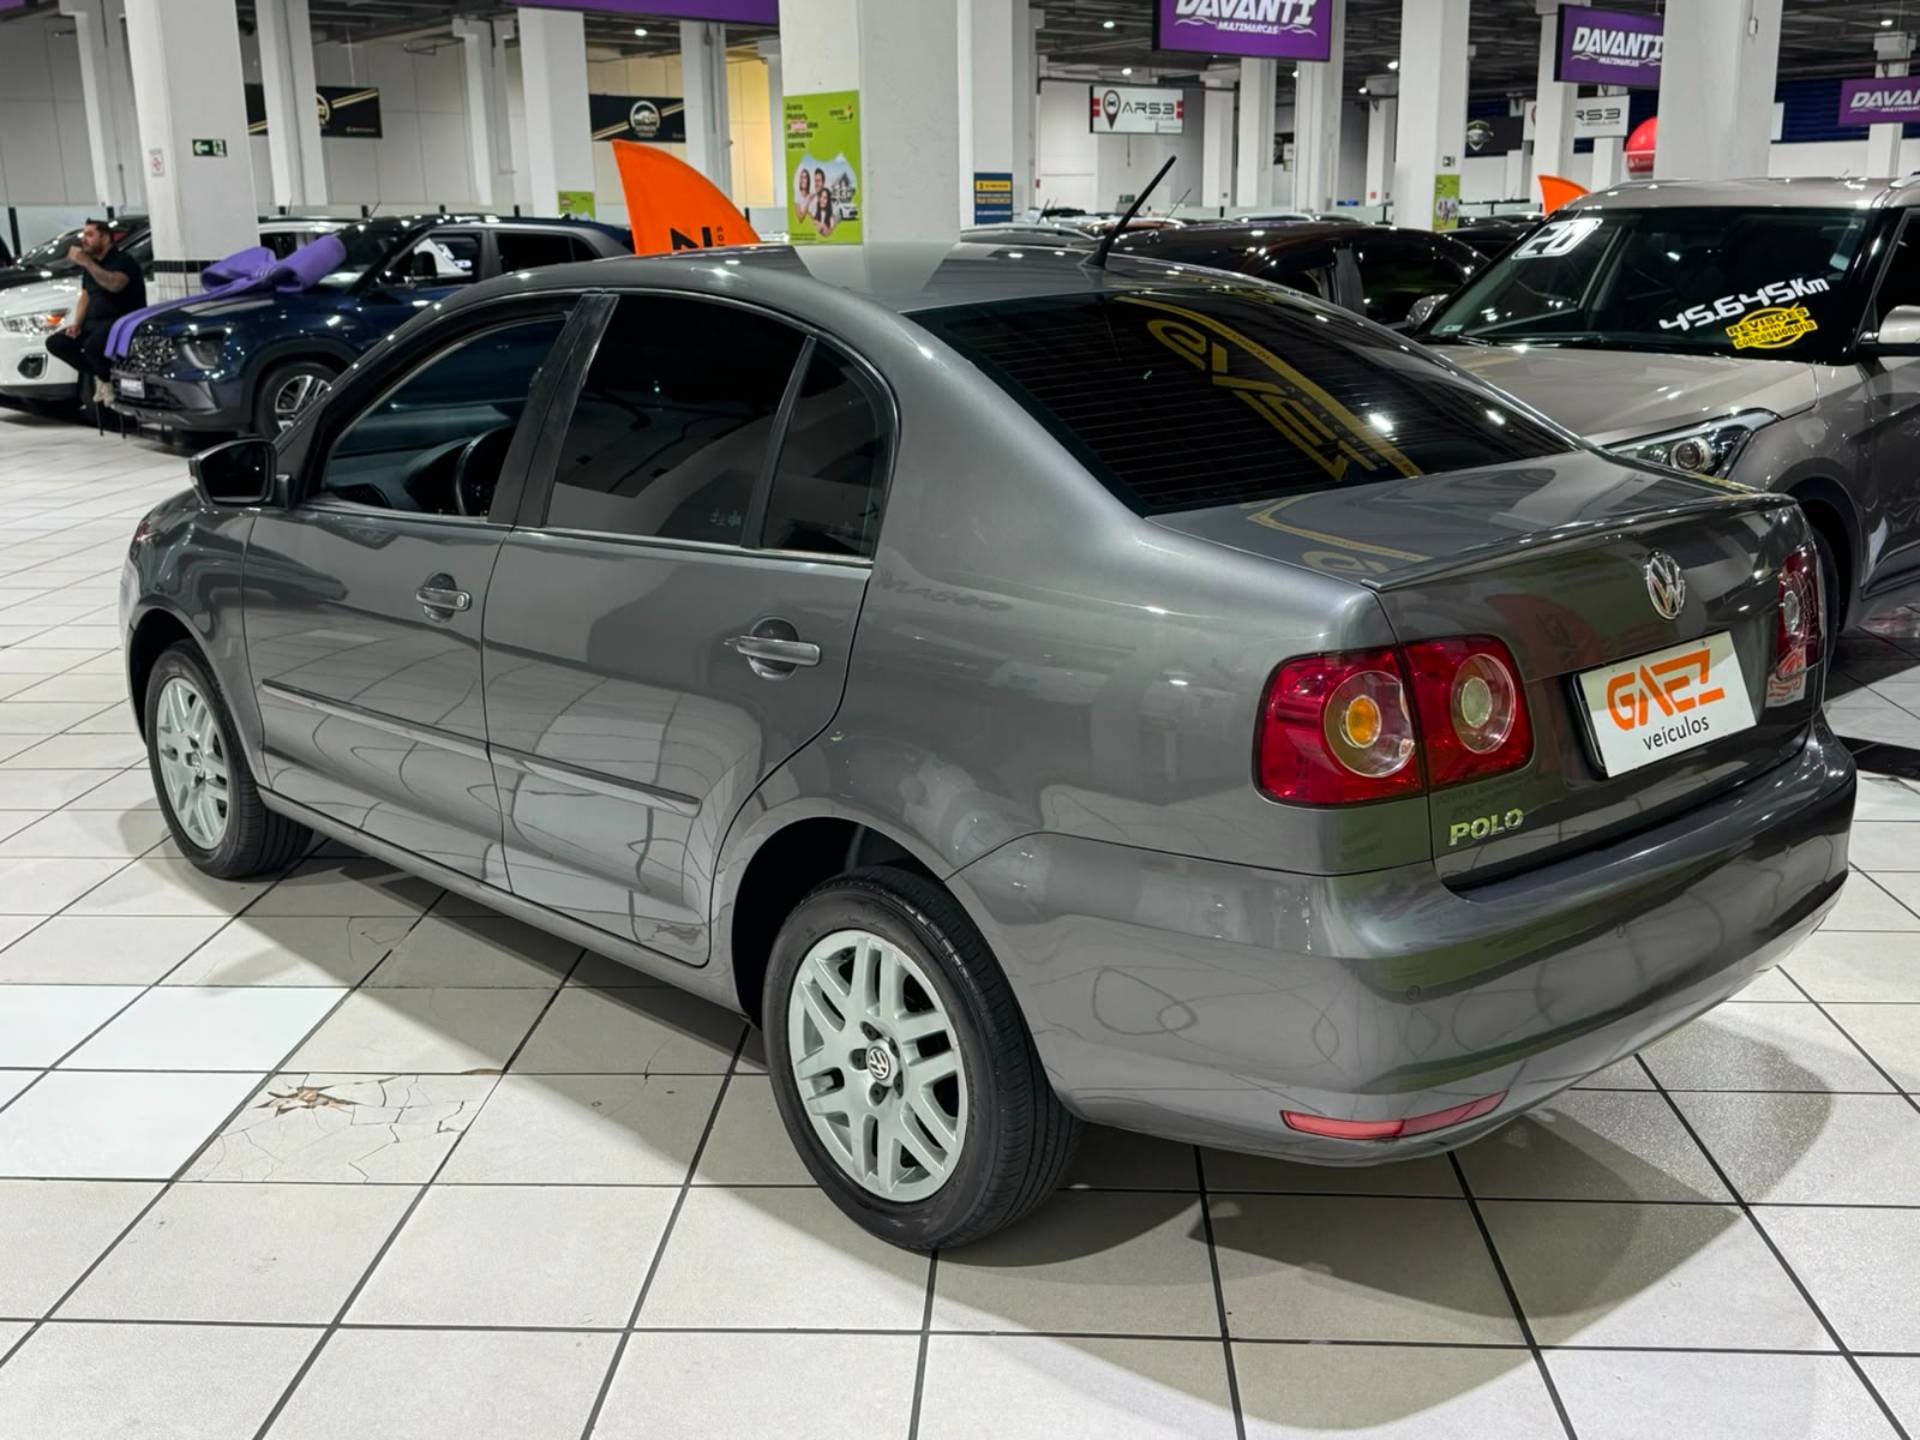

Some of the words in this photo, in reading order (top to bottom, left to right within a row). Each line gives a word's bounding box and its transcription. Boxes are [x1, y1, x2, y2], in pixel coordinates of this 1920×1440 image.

[1216, 22, 1281, 34] MULTIMARCAS
[1572, 27, 1664, 58] DAVANTI
[1121, 101, 1175, 114] ARS3
[1728, 307, 1809, 335] REVISÕES
[1735, 321, 1816, 348] concessionária
[1607, 649, 1725, 731] GAEZ
[1643, 716, 1710, 750] veículos
[1449, 808, 1524, 846] POLO
